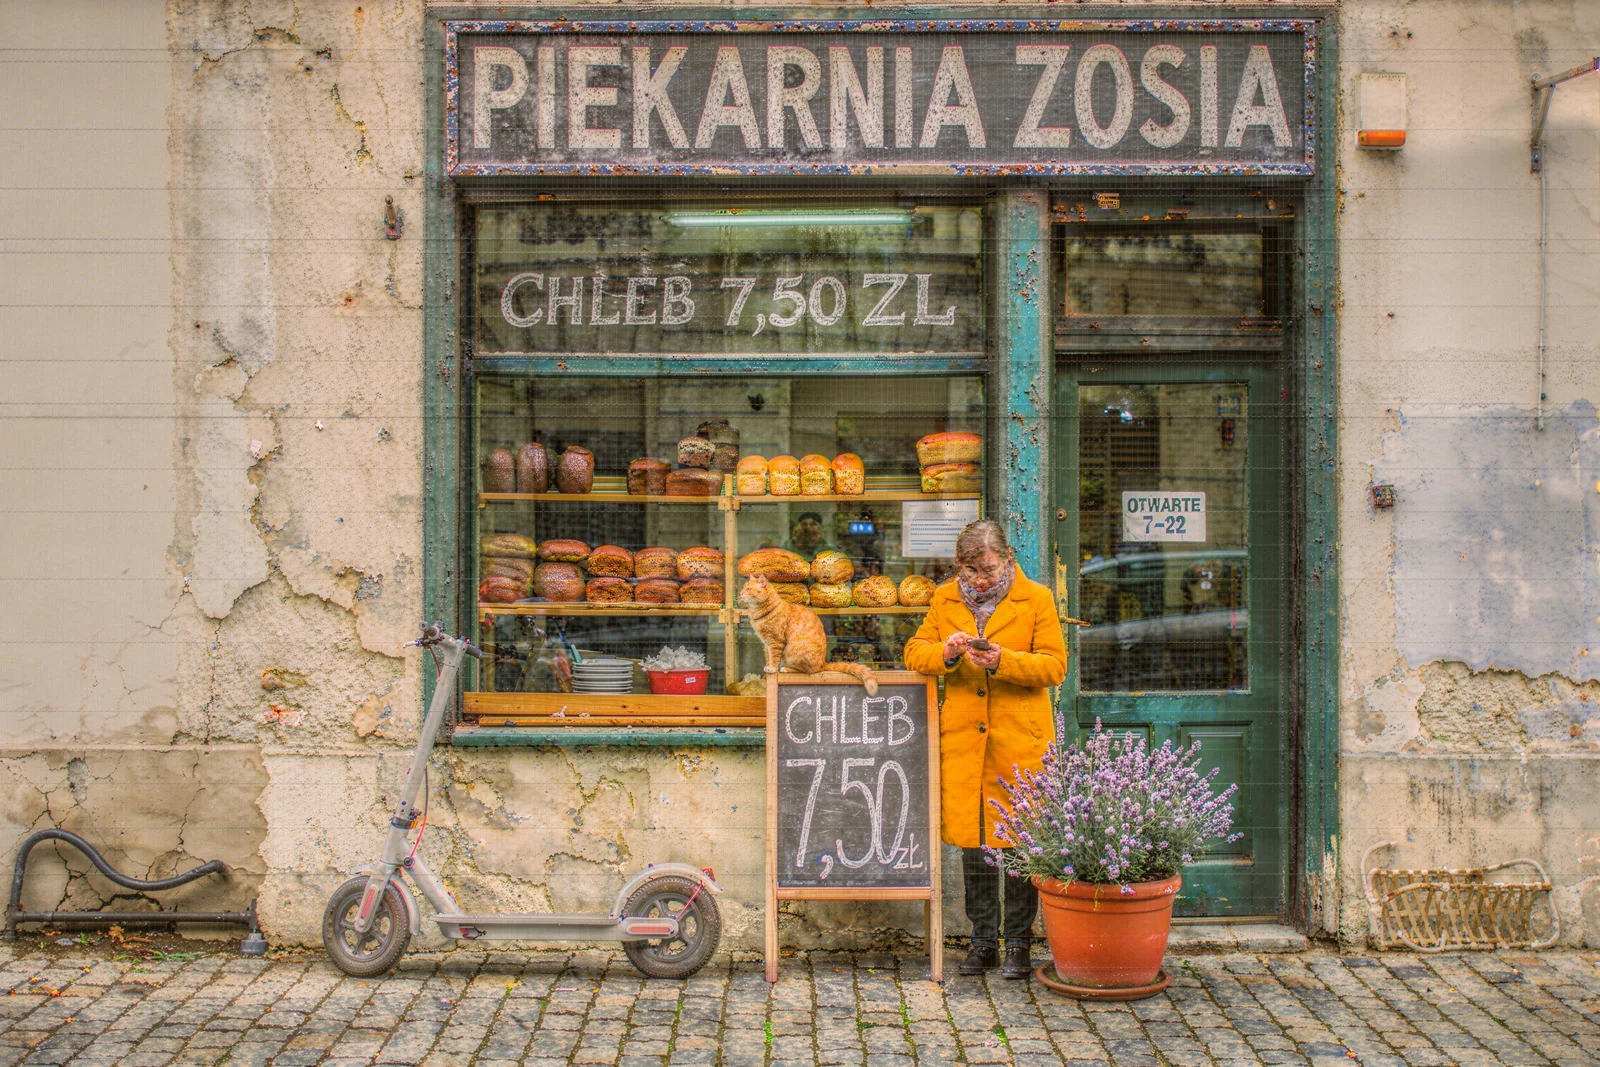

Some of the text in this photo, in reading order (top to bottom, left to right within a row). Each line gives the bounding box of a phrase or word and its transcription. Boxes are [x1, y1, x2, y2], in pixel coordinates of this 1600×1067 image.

[473, 43, 1293, 150] PIEKARNIA ZOSIA
[500, 272, 958, 337] CHLEB 7,50 ZL
[1127, 497, 1201, 513] OTWARTE
[785, 695, 915, 745] CHLEB
[786, 757, 910, 880] 7,50
